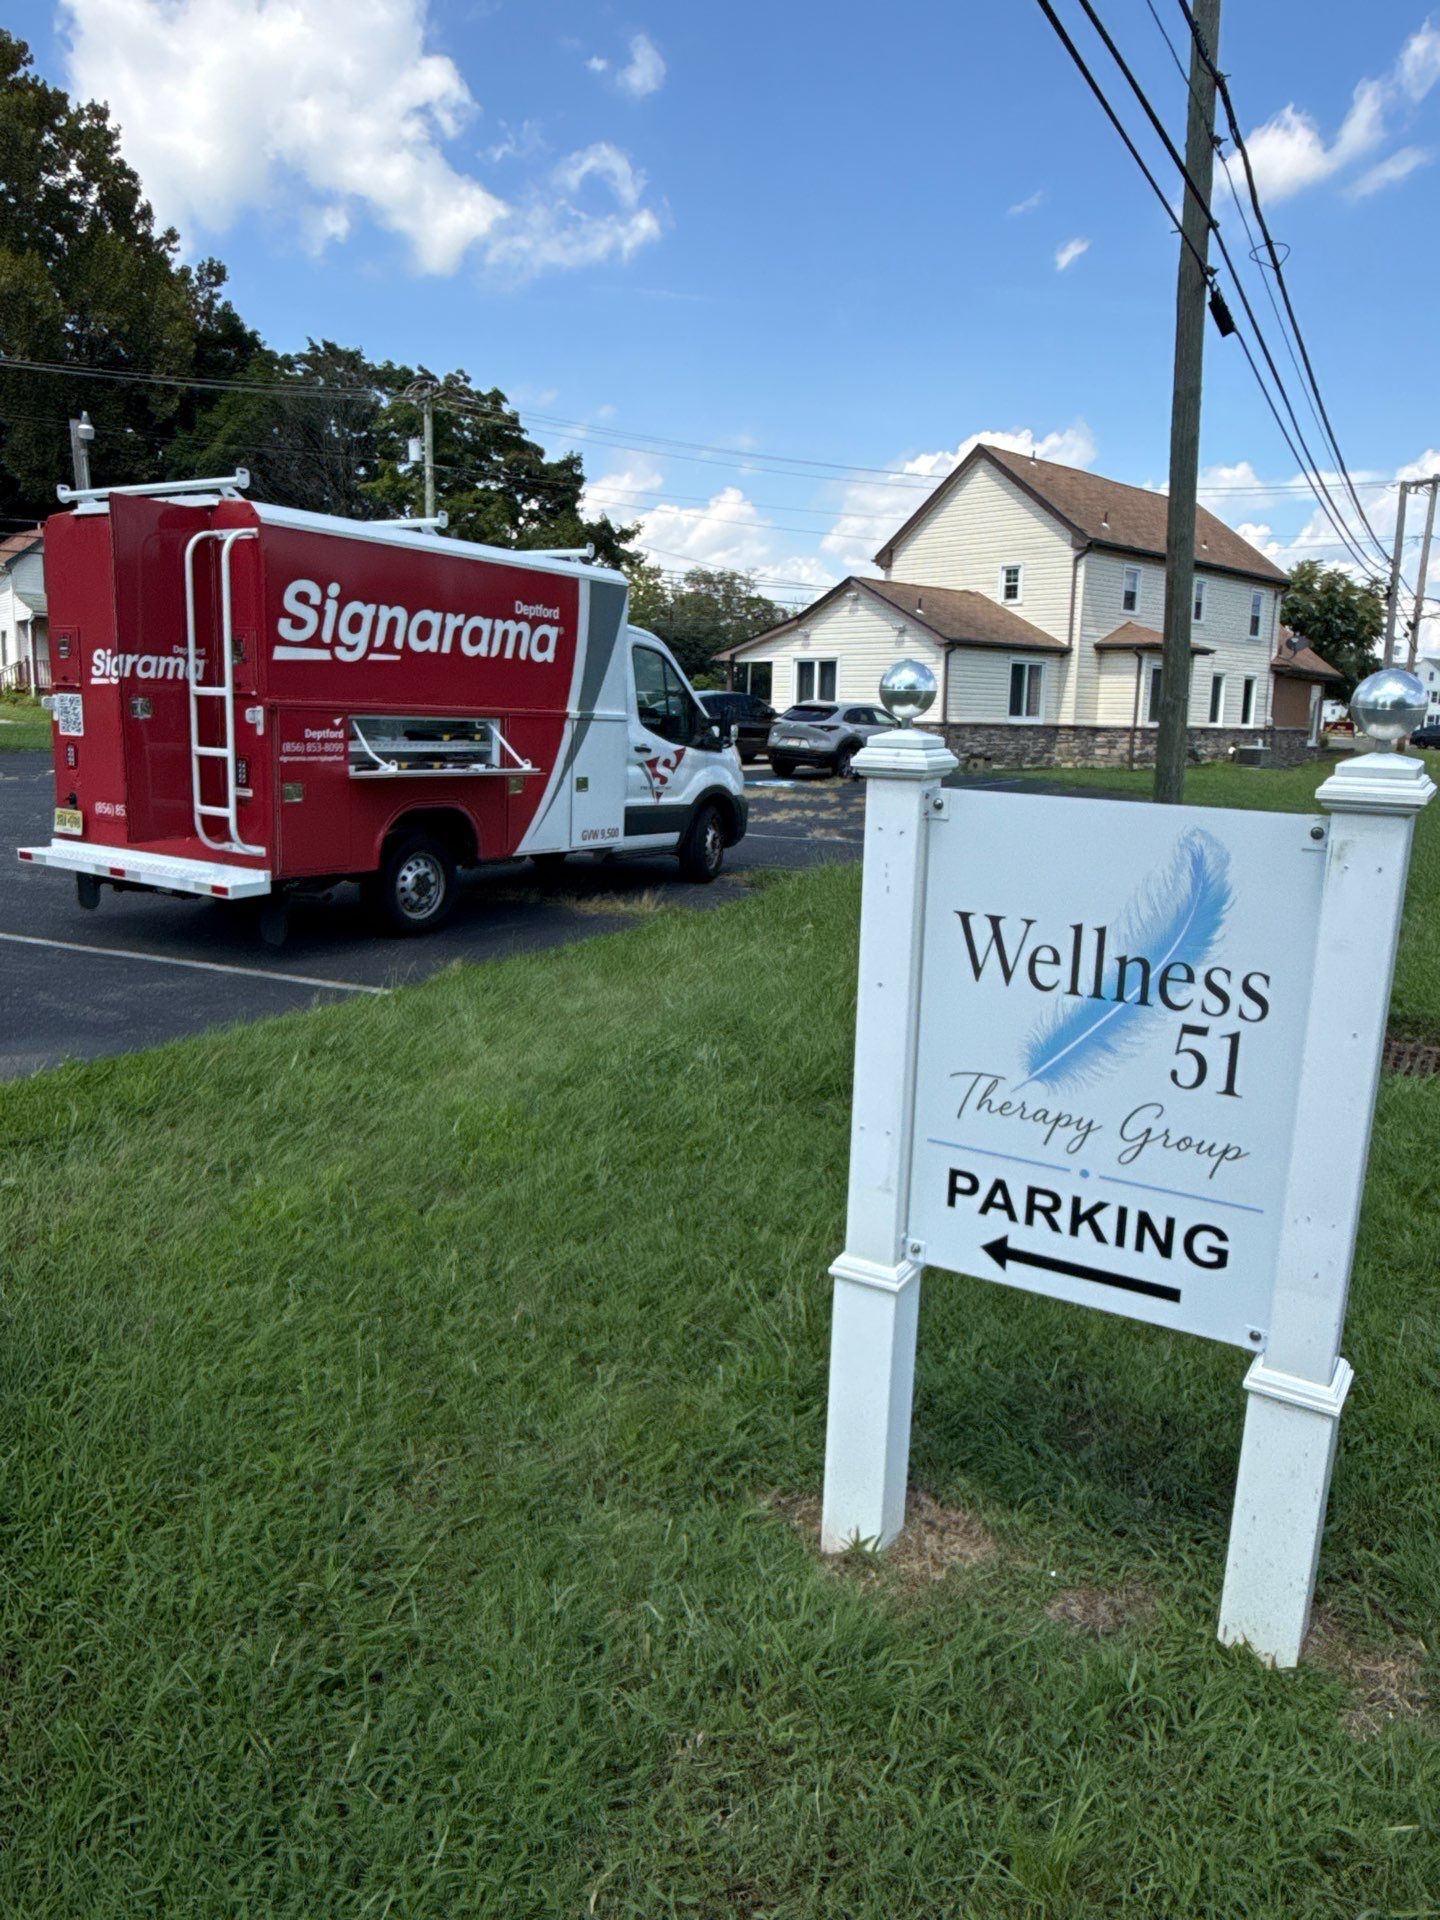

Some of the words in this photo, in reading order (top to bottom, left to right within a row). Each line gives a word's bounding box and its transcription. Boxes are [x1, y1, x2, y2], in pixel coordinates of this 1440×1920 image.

[277, 579, 560, 662] Signarama
[514, 600, 560, 619] Deptford
[304, 728, 345, 740] Deptford
[581, 829, 600, 841] GVW
[600, 827, 620, 840] 9,500
[953, 910, 1271, 1023] Wellness
[1169, 1023, 1243, 1098] 51
[950, 1071, 1102, 1155] Therapy
[1118, 1103, 1250, 1180] Group
[946, 1166, 1230, 1270] PARKING
